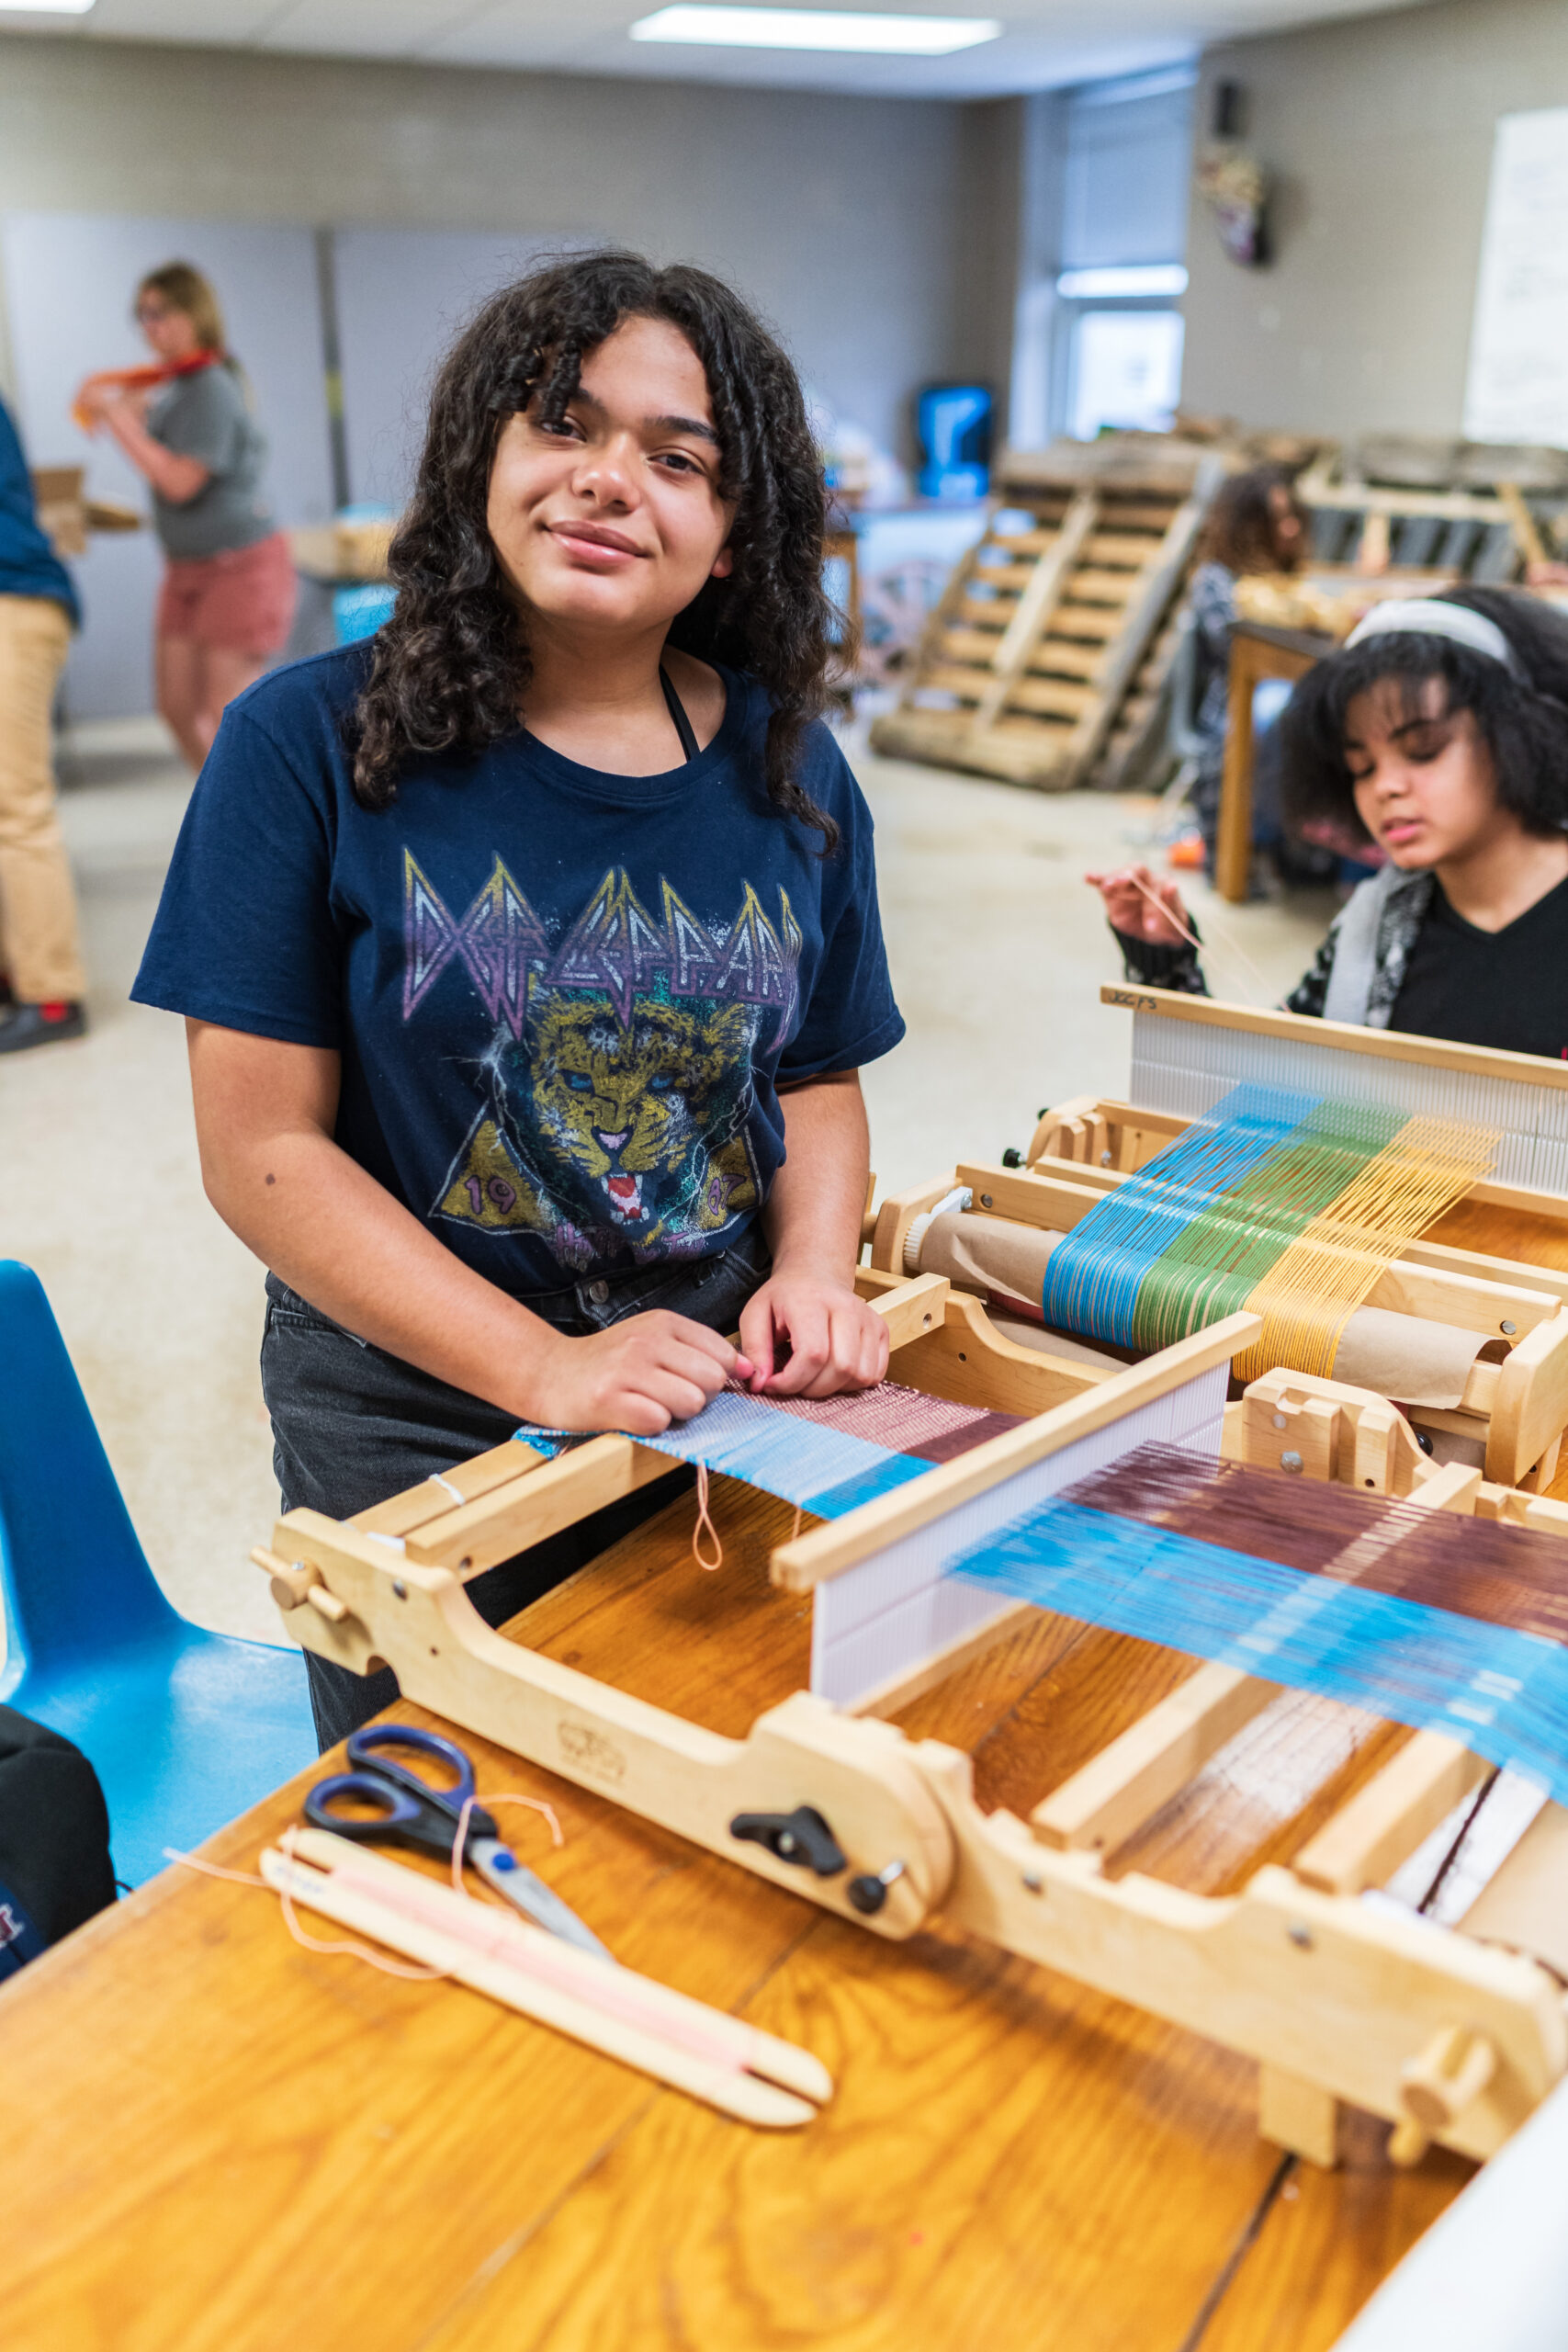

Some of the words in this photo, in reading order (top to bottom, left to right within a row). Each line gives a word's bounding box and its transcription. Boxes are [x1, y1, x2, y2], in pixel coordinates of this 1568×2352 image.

[404, 845, 553, 1042] DEF
[465, 1176, 516, 1215] 19
[708, 1174, 746, 1216] 87
